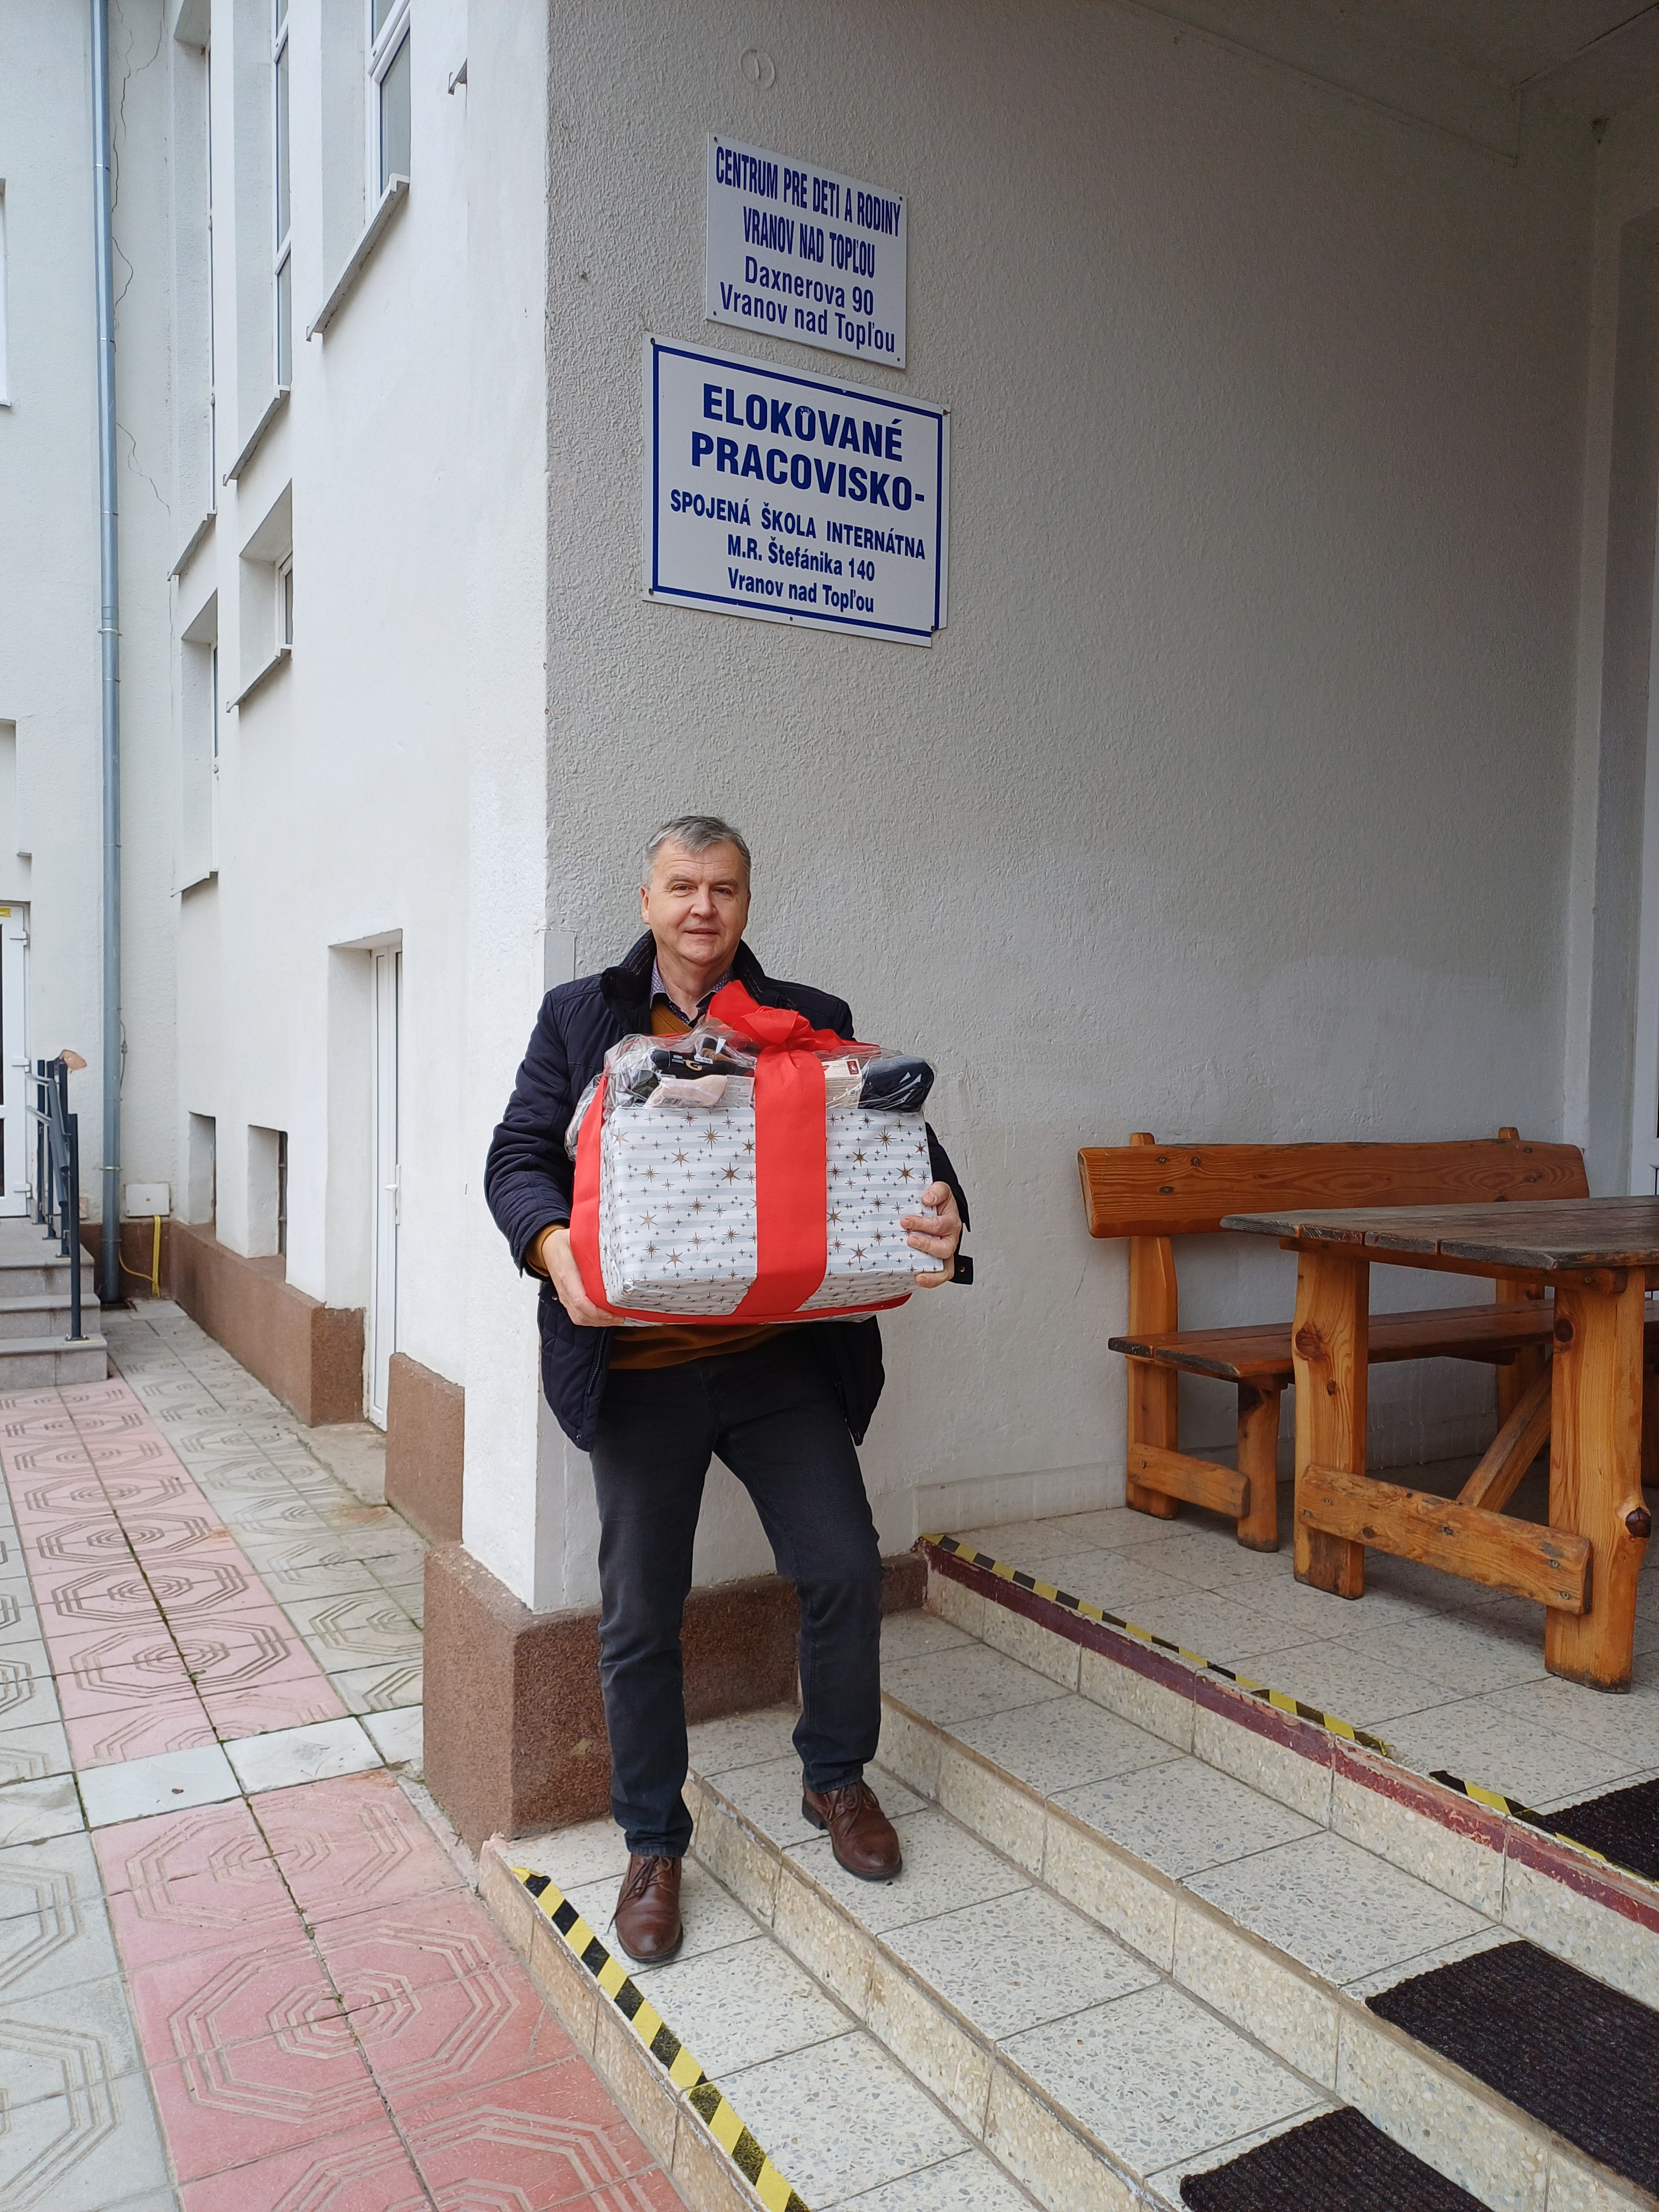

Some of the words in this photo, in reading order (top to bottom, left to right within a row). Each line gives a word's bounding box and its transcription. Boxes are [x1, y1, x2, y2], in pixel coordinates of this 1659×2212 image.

[716, 147, 778, 200] CENTRUM
[784, 168, 807, 208] PRE
[813, 177, 839, 218] DETI
[844, 188, 852, 223] A
[857, 191, 901, 237] RODINY
[743, 206, 794, 254] VRANOV
[800, 223, 824, 263] NAD
[830, 232, 875, 278] TOPĽOU
[721, 281, 787, 324] Vranov
[795, 308, 827, 335] nad
[834, 312, 894, 352] Topľou
[745, 256, 844, 308] Daxnerova
[853, 286, 873, 315] 90
[703, 383, 902, 462] ELOKOVANÉ
[692, 431, 924, 510] PRACOVISKO-
[671, 489, 750, 525] SPOJENÁ
[761, 502, 816, 538] ŠKOLA
[827, 521, 925, 560] INTERNÁTNA
[728, 534, 762, 561] M.R.
[768, 536, 842, 575] Štefánika
[849, 558, 875, 581] 140
[728, 567, 784, 597] Vranov
[789, 583, 817, 603] nad
[822, 584, 873, 613] Topľou
